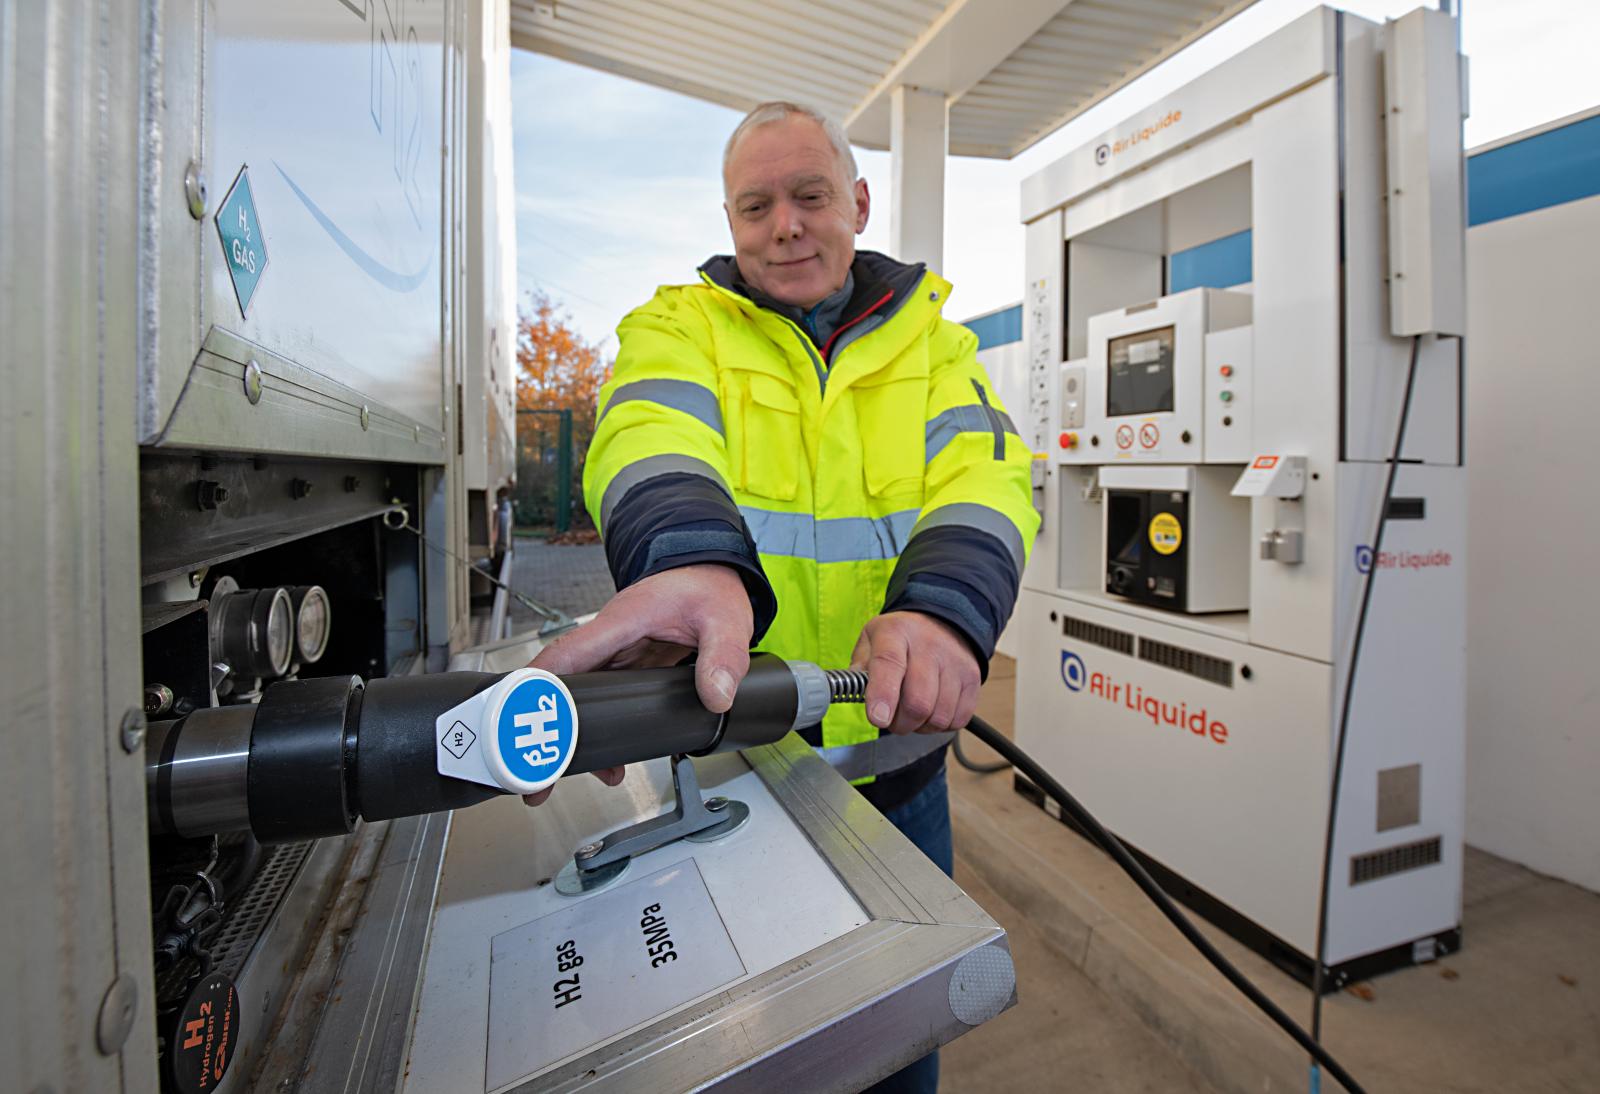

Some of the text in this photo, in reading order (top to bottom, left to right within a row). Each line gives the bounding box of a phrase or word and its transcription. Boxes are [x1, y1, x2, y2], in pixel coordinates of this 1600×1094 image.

[1113, 110, 1182, 155] Air Liquide
[238, 205, 251, 243] H2
[232, 238, 256, 274] GAS
[1375, 549, 1452, 571] Air Liquide
[513, 693, 560, 750] H2
[1090, 671, 1229, 745] Air Liquide
[454, 731, 464, 748] H2
[640, 902, 678, 969] 35MPa
[553, 940, 584, 1009] H2 gas
[183, 1000, 213, 1050] H2
[200, 1015, 215, 1088] Hydrogen
